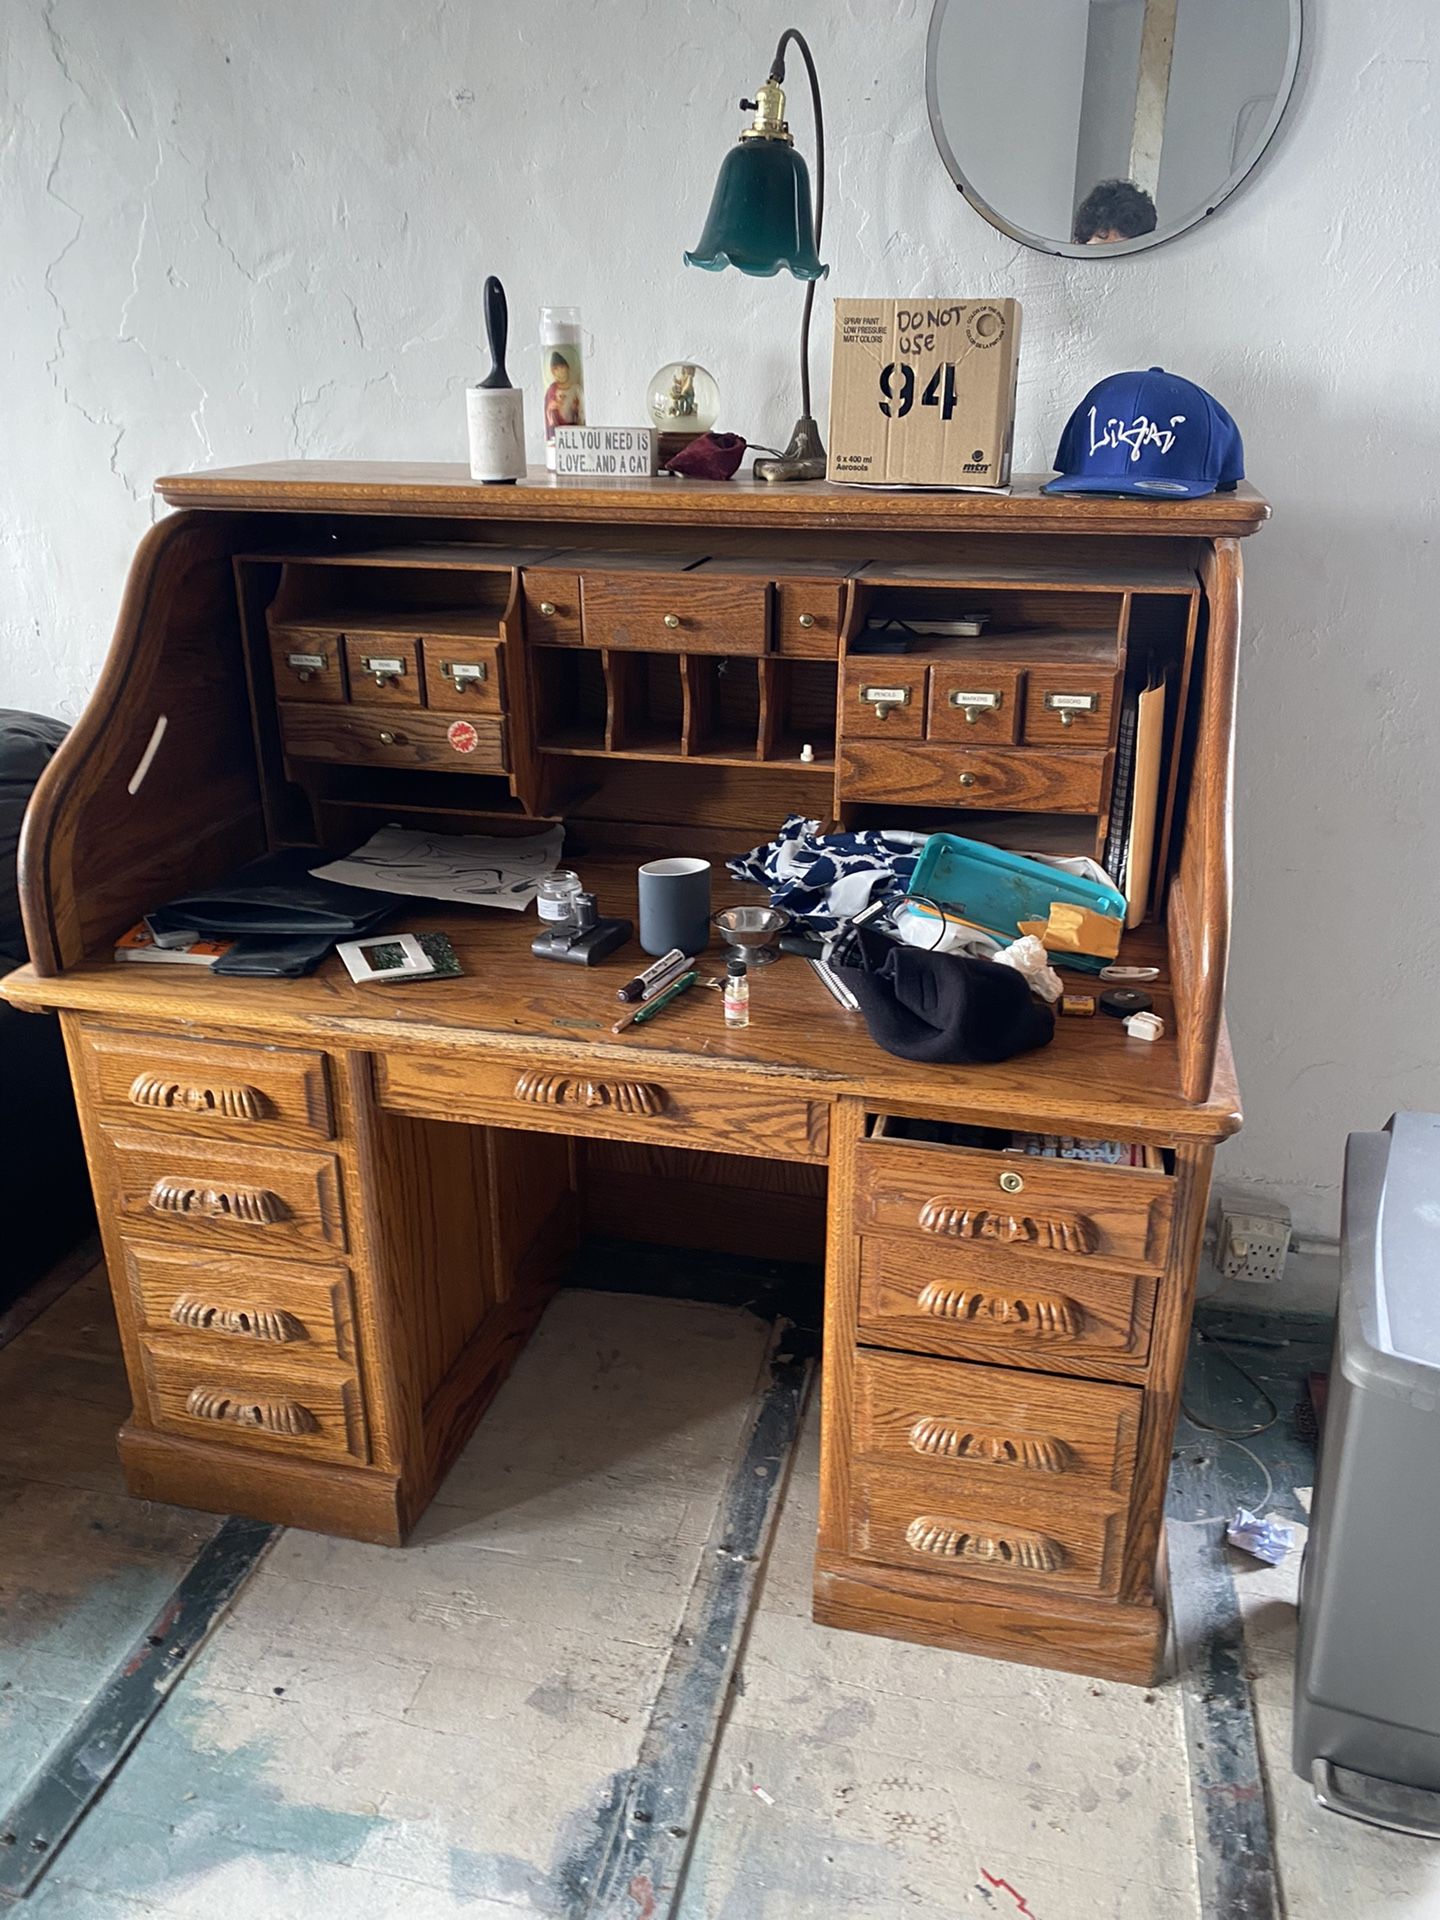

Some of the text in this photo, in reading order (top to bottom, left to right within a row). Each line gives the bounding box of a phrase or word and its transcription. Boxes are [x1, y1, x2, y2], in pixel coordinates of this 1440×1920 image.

[843, 317, 880, 325] SPRAY PAINT
[897, 305, 967, 333] DO NOT
[843, 326, 887, 335] LOW PRESSURE
[843, 335, 883, 343] MATT COLORS
[899, 333, 935, 355] USE
[878, 361, 958, 420] 94
[558, 431, 648, 451] ALL YOU NEED IS
[619, 455, 627, 473] A
[629, 455, 648, 473] CAT
[848, 455, 862, 463] 400
[836, 463, 868, 471] Aerosols
